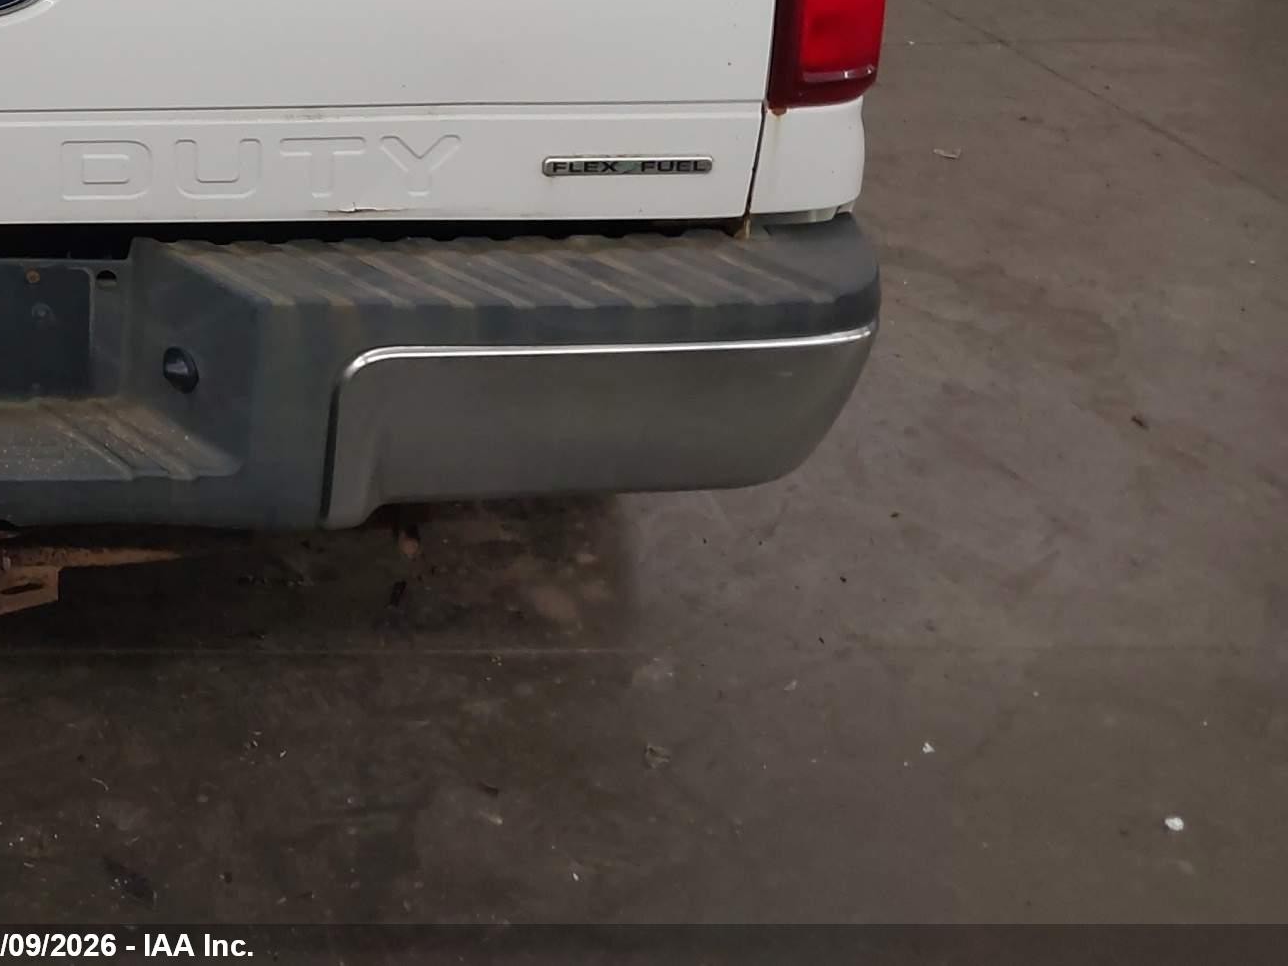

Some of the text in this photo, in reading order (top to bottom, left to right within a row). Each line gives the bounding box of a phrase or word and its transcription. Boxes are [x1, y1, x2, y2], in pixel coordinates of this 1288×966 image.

[60, 134, 462, 201] DUTY
[552, 160, 707, 173] FLEX FUEL
